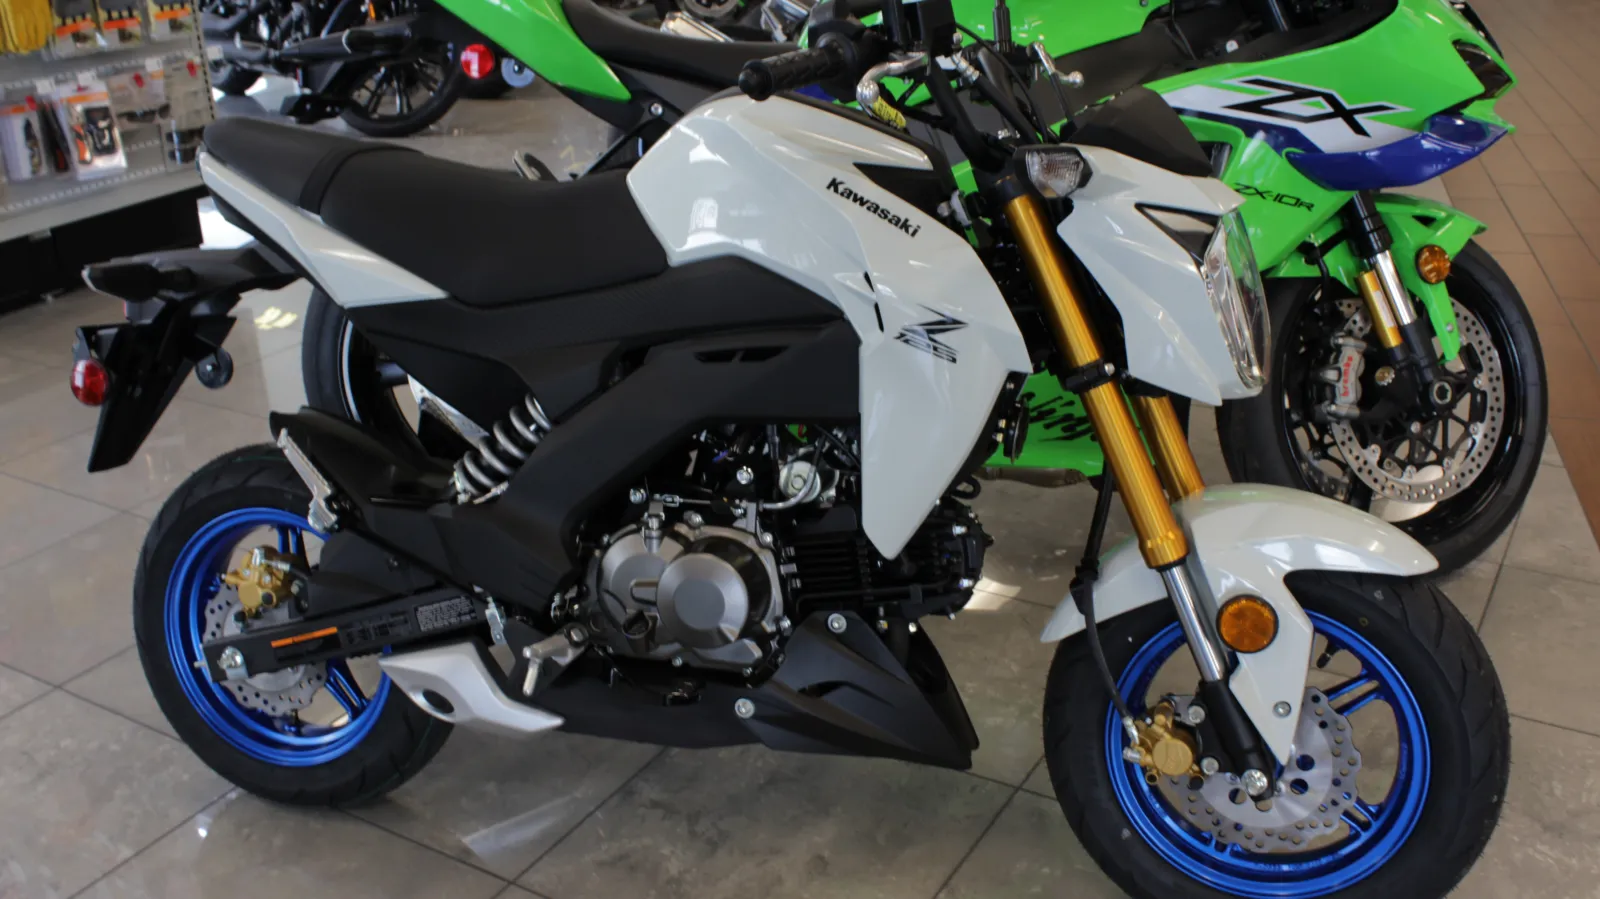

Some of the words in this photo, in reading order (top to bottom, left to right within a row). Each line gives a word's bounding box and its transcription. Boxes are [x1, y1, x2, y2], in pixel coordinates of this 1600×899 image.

[1221, 77, 1399, 138] ZX
[826, 177, 922, 239] Kawasaki
[1233, 182, 1315, 212] ZX-10R
